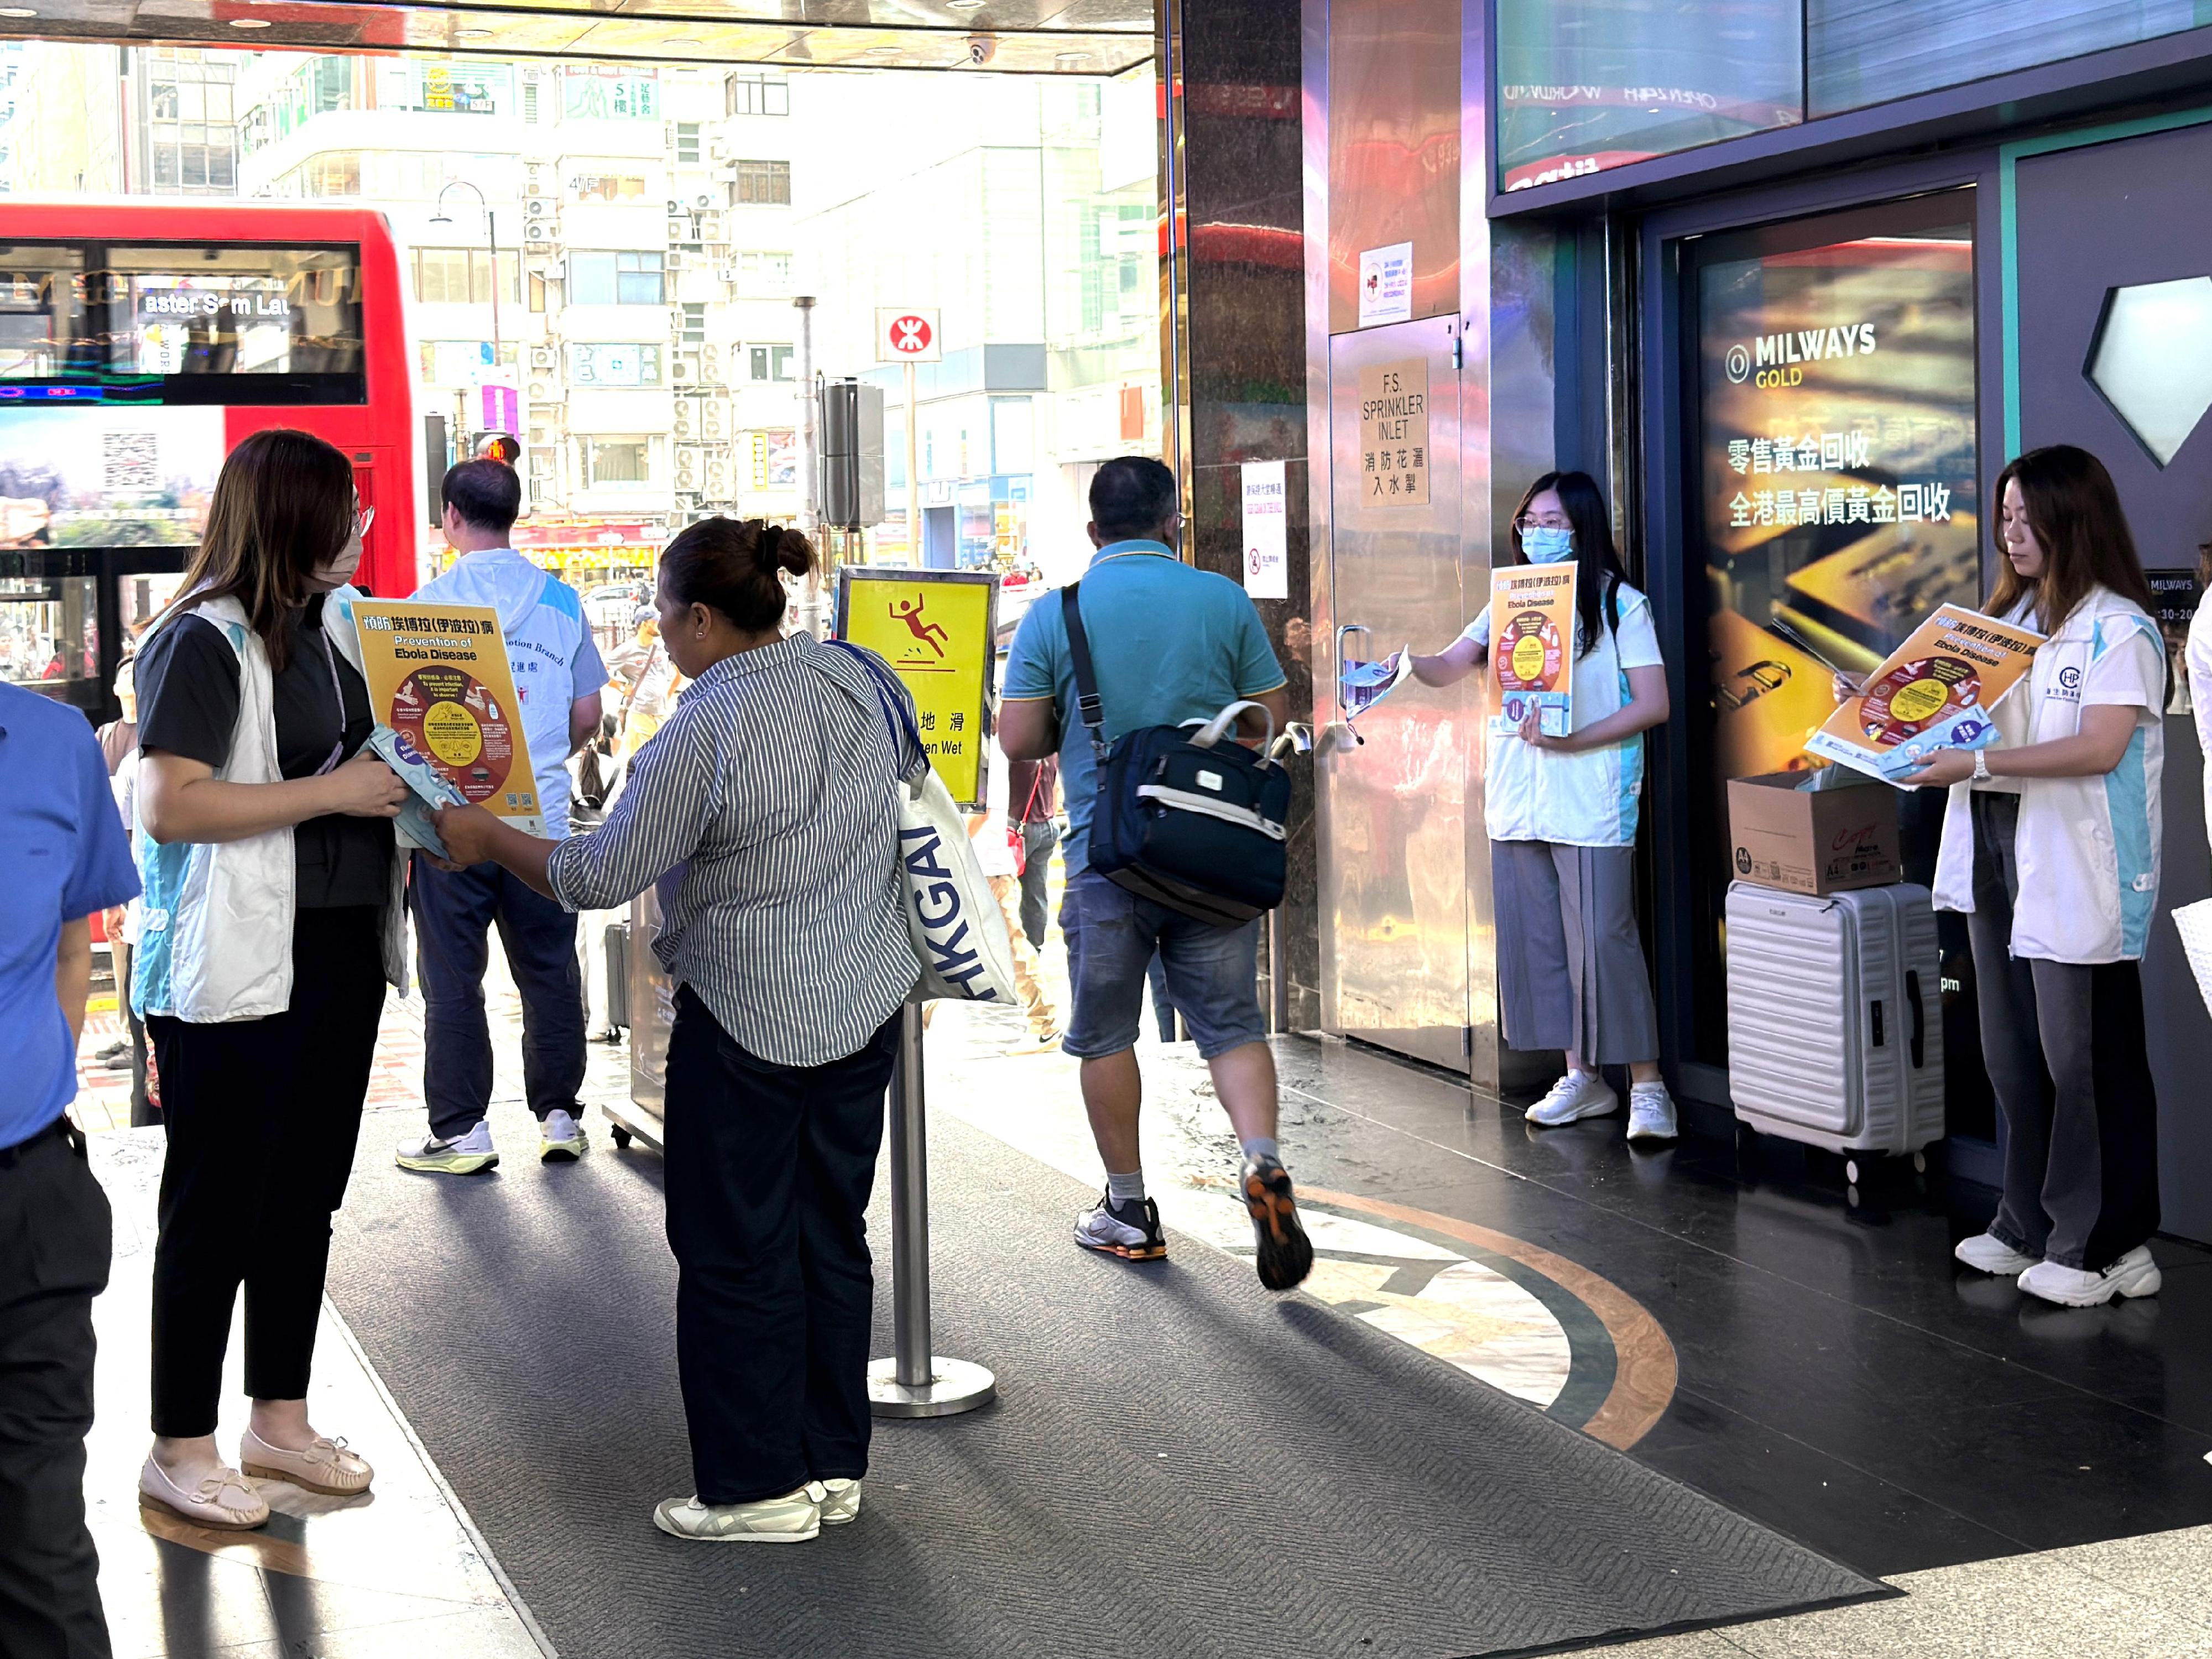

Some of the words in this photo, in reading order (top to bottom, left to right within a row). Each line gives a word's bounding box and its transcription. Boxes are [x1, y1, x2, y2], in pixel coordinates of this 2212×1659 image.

[1755, 323, 1876, 367] MILWAYS
[1384, 373, 1402, 394] F.S.
[1755, 367, 1803, 389] GOLD
[1363, 394, 1423, 420] SPRINKLER
[1379, 419, 1408, 441] INLET
[1728, 430, 1870, 475] 零售黃金回收
[1729, 482, 1951, 528] 全港最高價黃金回收
[2151, 580, 2193, 591] MILWAYS
[1508, 600, 1526, 608] Ebola
[1527, 599, 1554, 608] Disease
[362, 615, 494, 635] 預防埃博拉(伊波拉)病
[394, 635, 458, 647] Prevention
[461, 637, 472, 648] of
[395, 648, 427, 660] Ebola
[431, 649, 478, 661] Disease
[535, 642, 564, 667] Branch
[1934, 639, 1961, 654] Ebola
[1960, 648, 2000, 667] Disease
[921, 743, 937, 754] en
[941, 740, 962, 754] Wet
[899, 826, 998, 1001] HKGAI
[1940, 977, 1959, 993] pm
